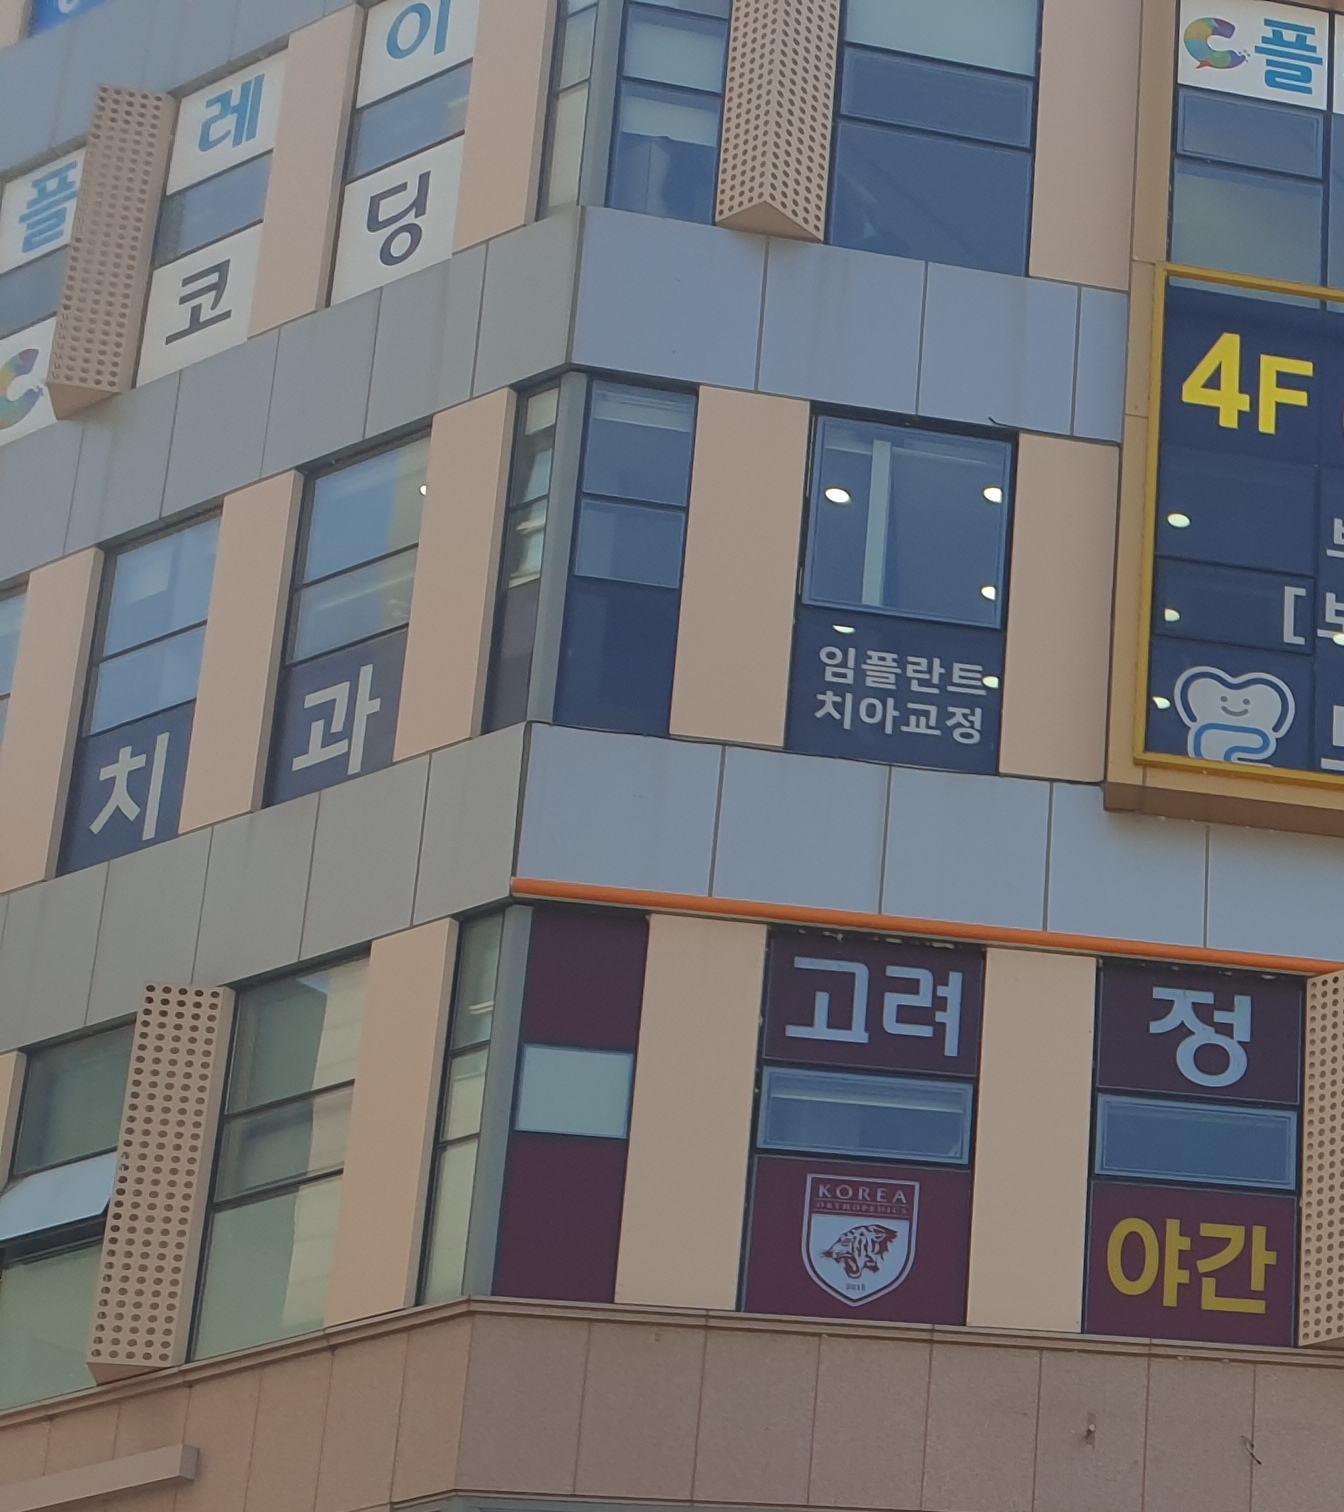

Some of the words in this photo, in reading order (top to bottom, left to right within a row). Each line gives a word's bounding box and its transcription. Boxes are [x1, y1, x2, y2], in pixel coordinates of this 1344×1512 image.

[1181, 333, 1314, 435] 4F
[818, 642, 994, 700] 임플란트
[812, 690, 990, 748] 치아교정
[784, 954, 963, 1057] 고려
[817, 1183, 908, 1204] KOREA
[1105, 1216, 1275, 1314] 야간
